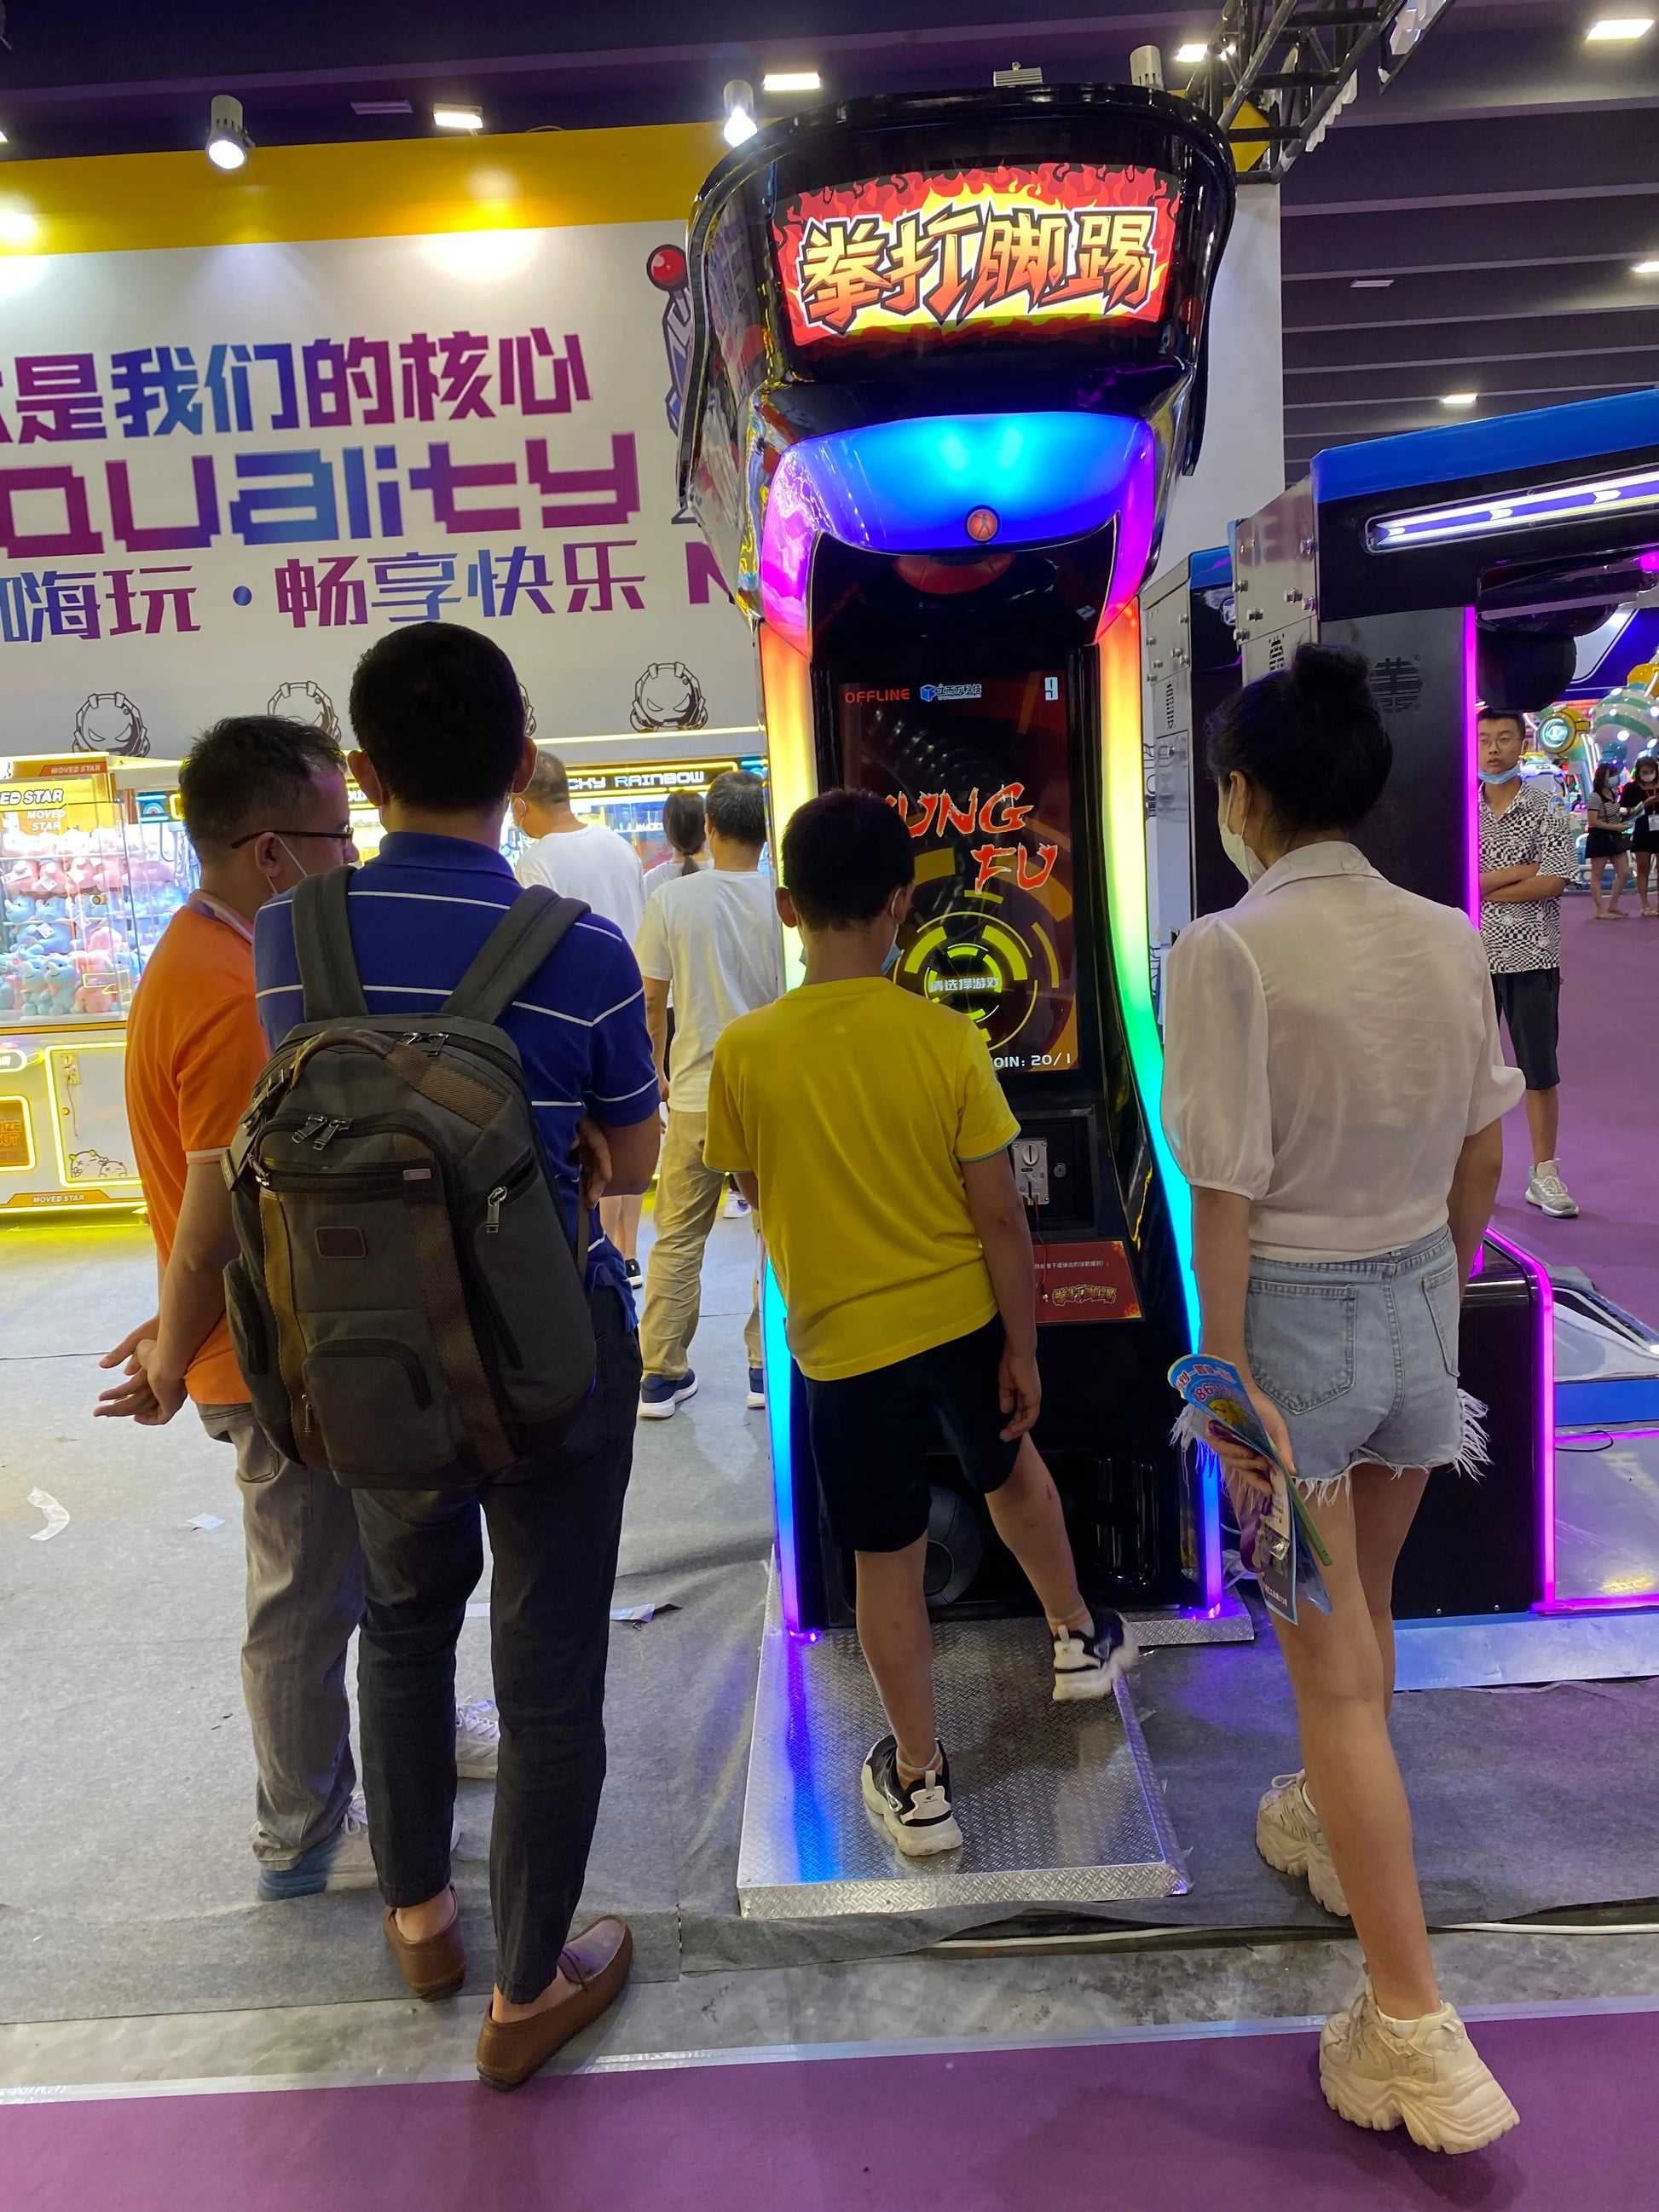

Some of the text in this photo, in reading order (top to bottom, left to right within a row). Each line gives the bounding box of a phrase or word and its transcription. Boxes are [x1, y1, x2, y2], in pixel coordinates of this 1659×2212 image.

[801, 203, 1156, 334] 拳打脚踢
[0, 327, 592, 443] 是我们的核心
[844, 688, 910, 703] OFFLINE
[51, 764, 101, 775] MOVED STAR
[615, 771, 705, 788] RAINBOW
[0, 788, 64, 806] ED STAR
[27, 809, 66, 819] MOVED
[885, 782, 1034, 838] UNG
[32, 822, 61, 832] STAR
[970, 842, 1058, 895] FU
[930, 977, 1000, 992] 请选择游戏
[991, 1056, 1026, 1068] OIN:
[32, 1194, 84, 1204] MOVED STAR
